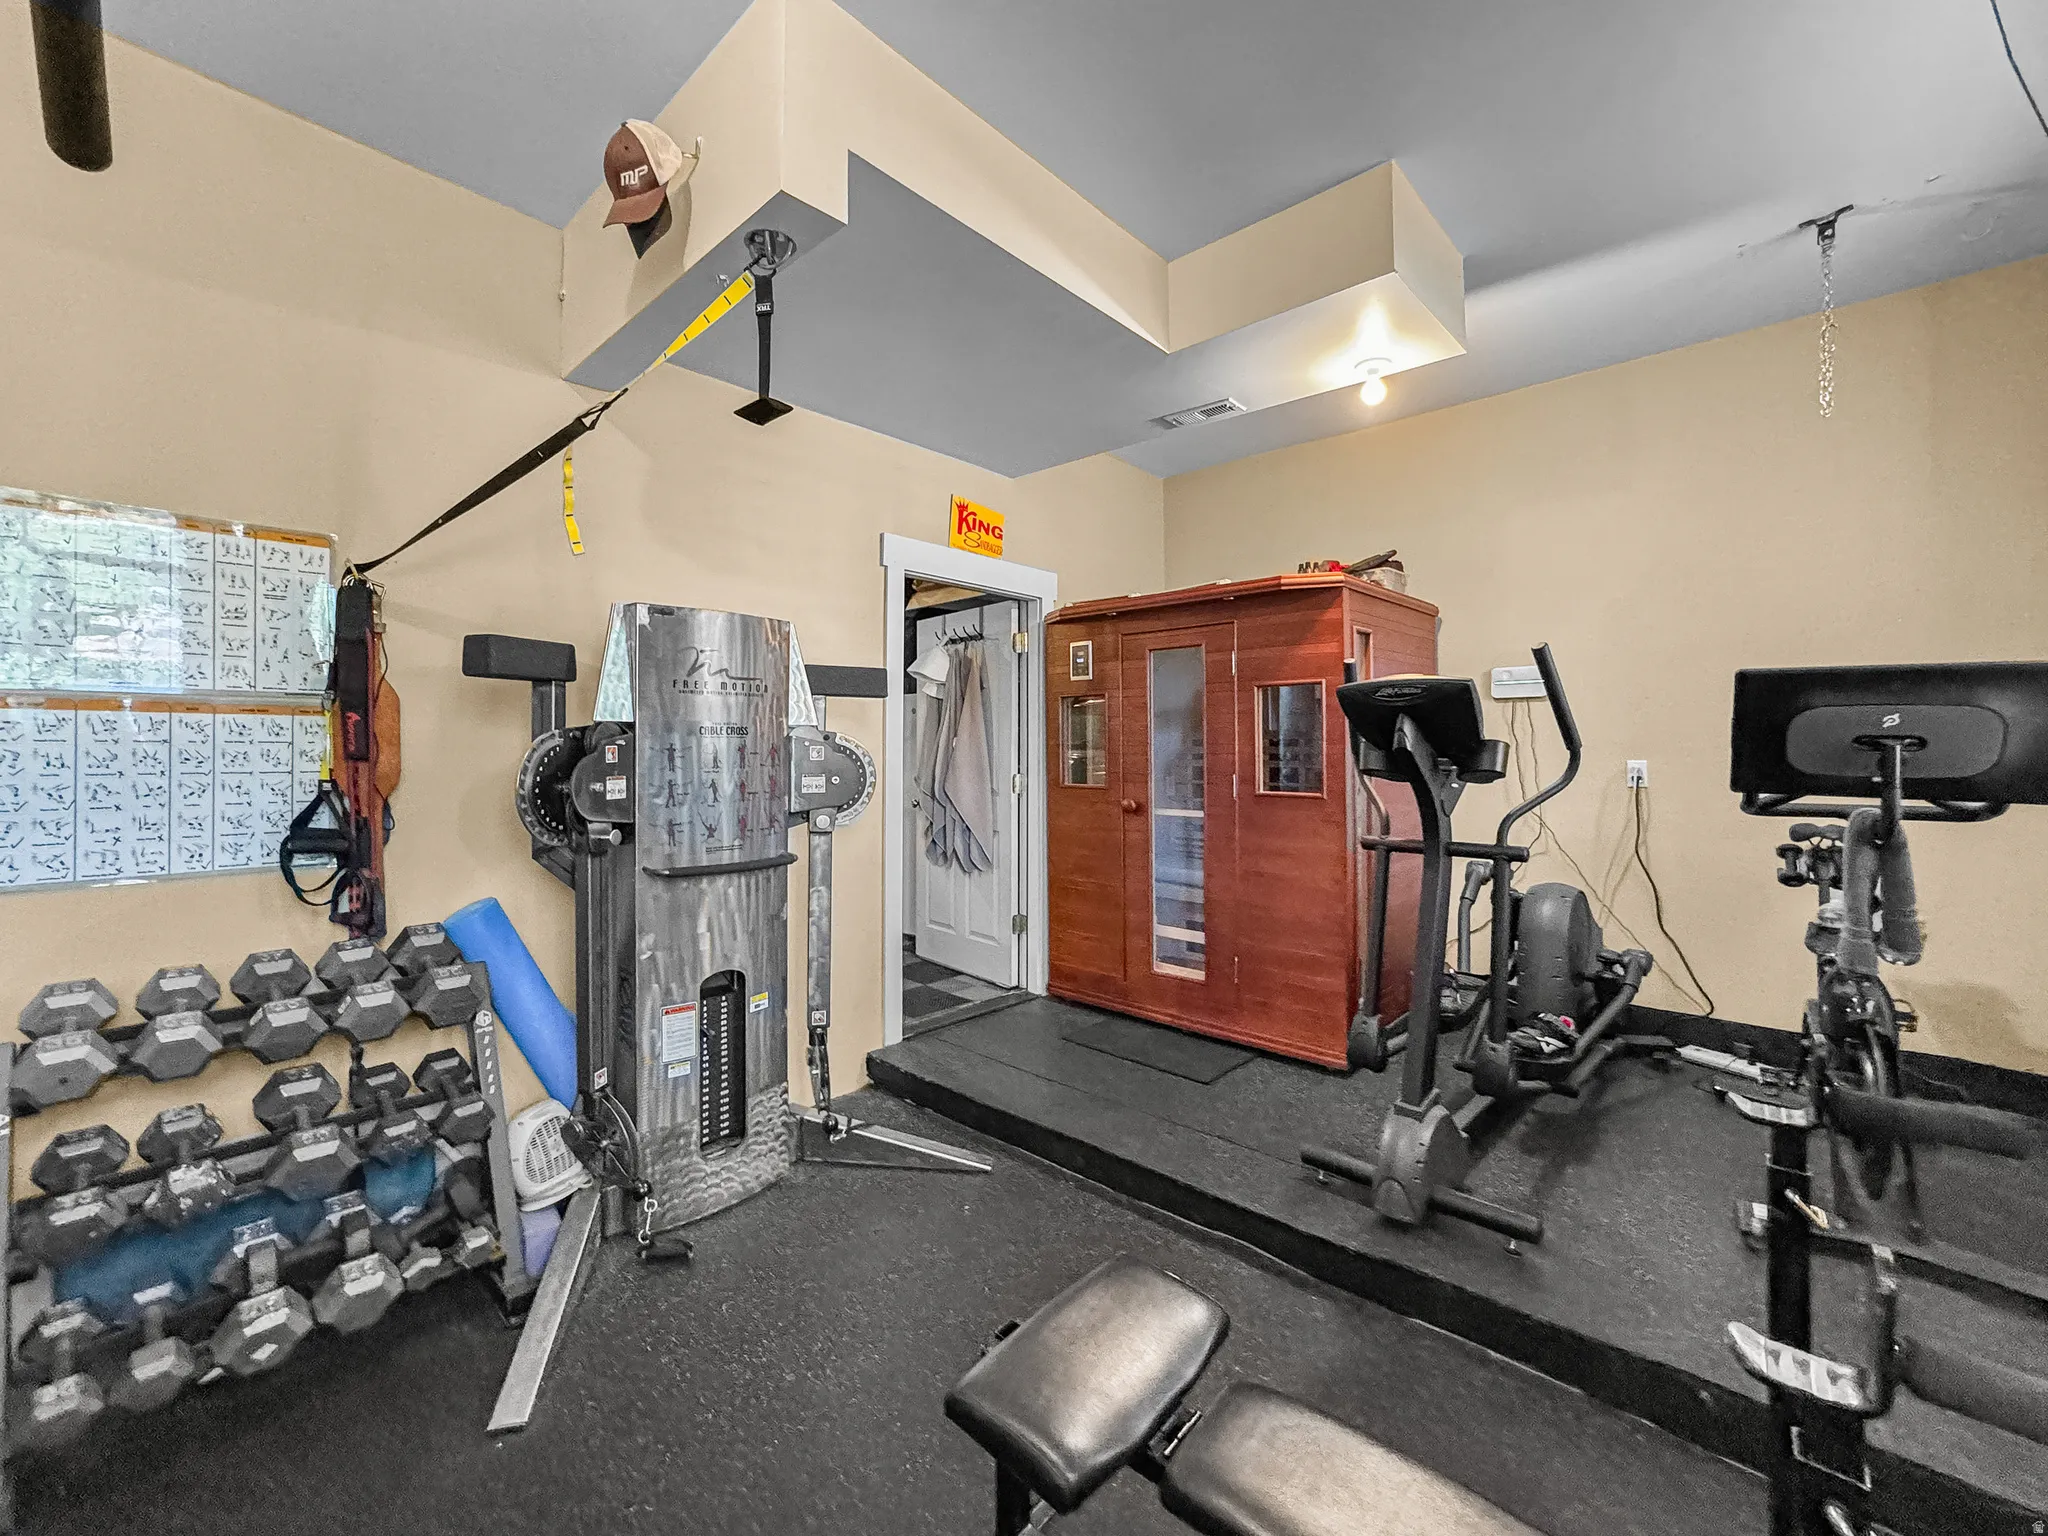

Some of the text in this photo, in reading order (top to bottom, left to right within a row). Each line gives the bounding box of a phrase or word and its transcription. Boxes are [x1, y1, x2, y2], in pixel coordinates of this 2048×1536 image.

[756, 304, 771, 312] TRX
[956, 503, 1004, 541] KING
[673, 679, 769, 694] FREE MOTION
[699, 725, 749, 736] CABLE CROSS
